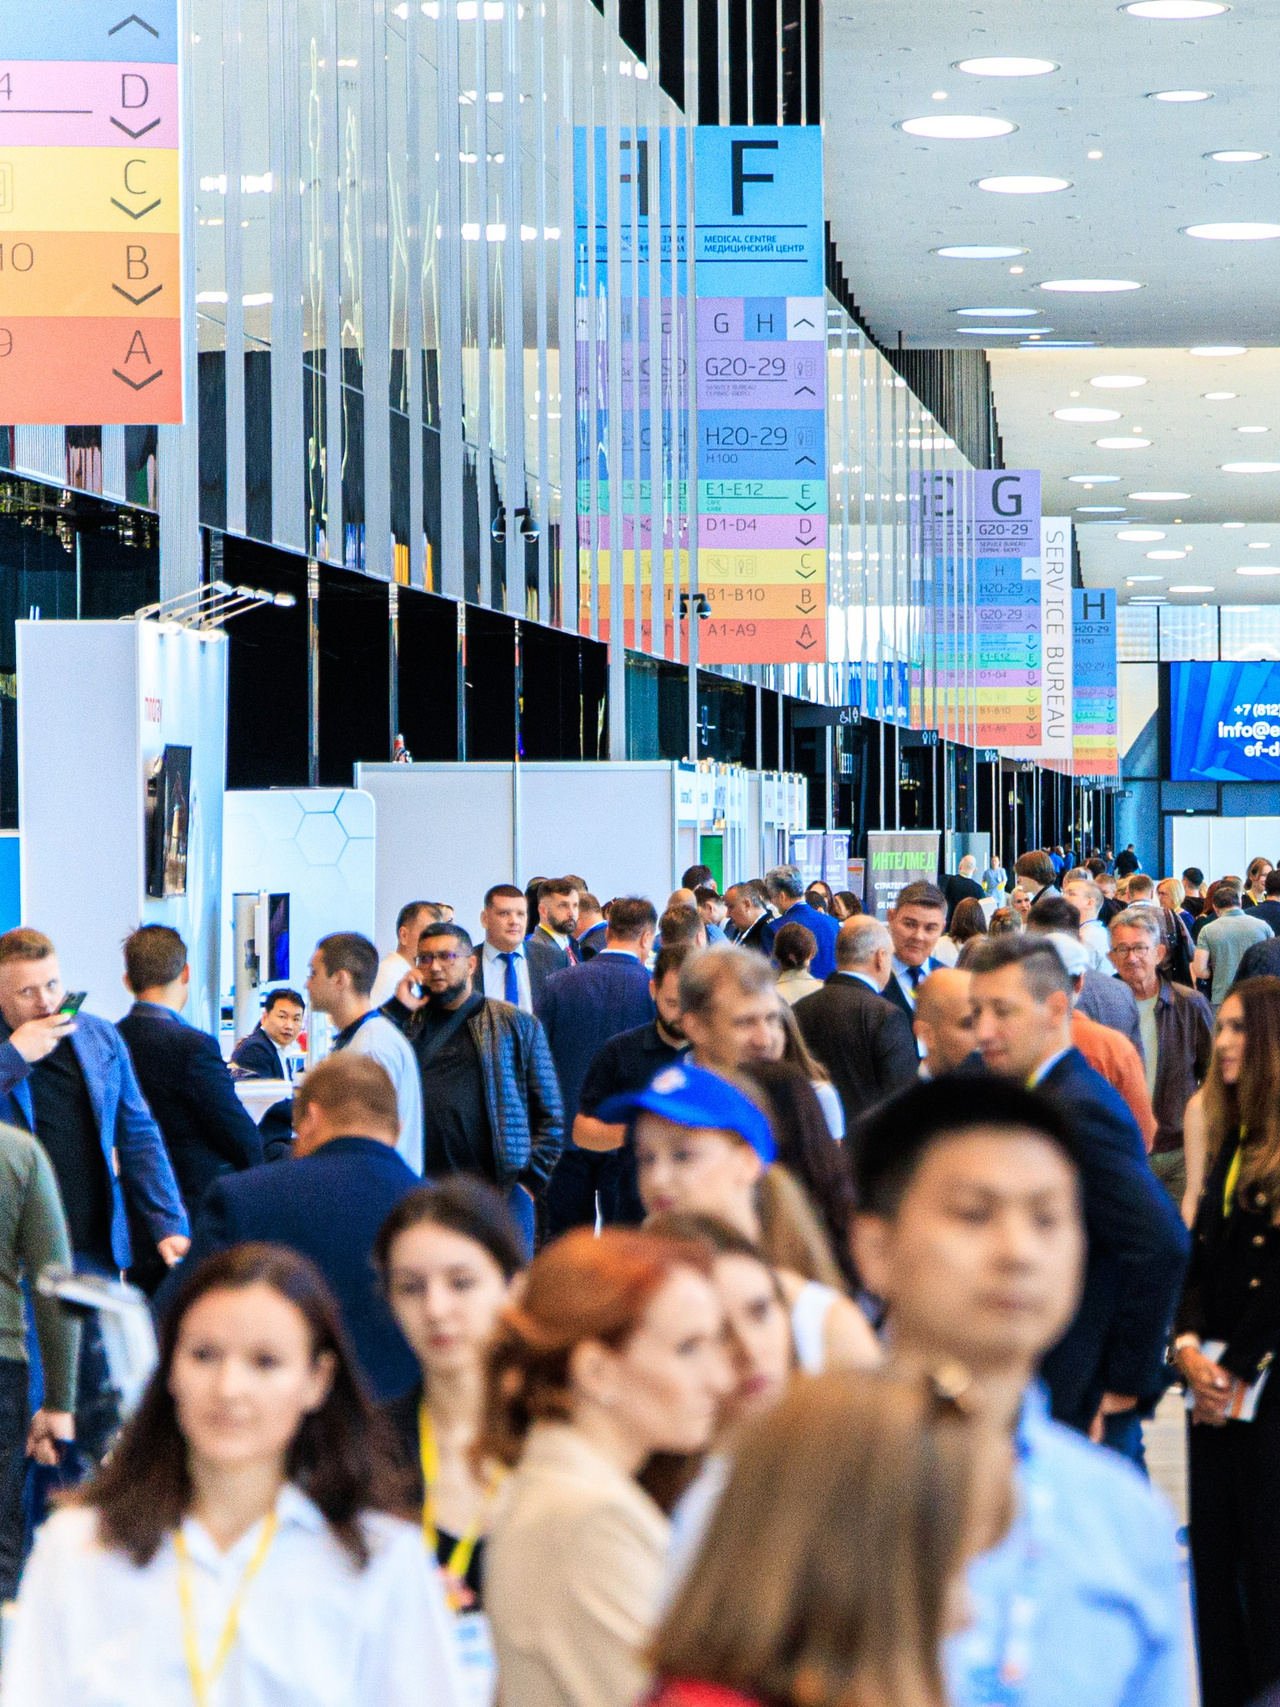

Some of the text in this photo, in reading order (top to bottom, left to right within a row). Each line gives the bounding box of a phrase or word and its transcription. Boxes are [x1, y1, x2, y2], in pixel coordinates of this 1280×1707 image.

[121, 73, 149, 109] D
[124, 159, 147, 194] C
[731, 140, 778, 216] F
[704, 235, 777, 243] MEDICAL CENTRE
[704, 243, 804, 253] МЕДИЦИНСКИЙ ЦЕНТР
[126, 245, 149, 280] B
[714, 313, 729, 333] G
[757, 313, 773, 333] H
[124, 330, 151, 364] A
[705, 357, 785, 376] G20-29
[706, 427, 788, 446] H20-29
[706, 454, 738, 463] H100
[706, 483, 763, 496] E1-E12
[801, 484, 811, 499] E
[991, 476, 1022, 517] G
[706, 518, 757, 531] D1-D4
[800, 519, 812, 533] D
[979, 524, 1028, 535] G20-29
[801, 554, 811, 568] C
[995, 565, 1004, 576] H
[707, 588, 765, 601] B1-B10
[980, 583, 1023, 593] H20-29
[801, 589, 812, 604] B
[1083, 592, 1105, 620] H
[980, 609, 1022, 620] G20-29
[708, 623, 756, 636] A1-A9
[800, 624, 812, 639] A
[1046, 531, 1065, 738] SERVICE BUREAU
[1074, 625, 1109, 633] H20-29
[1233, 704, 1251, 716] +7
[872, 851, 936, 873] ИНТЕЛМЕД
